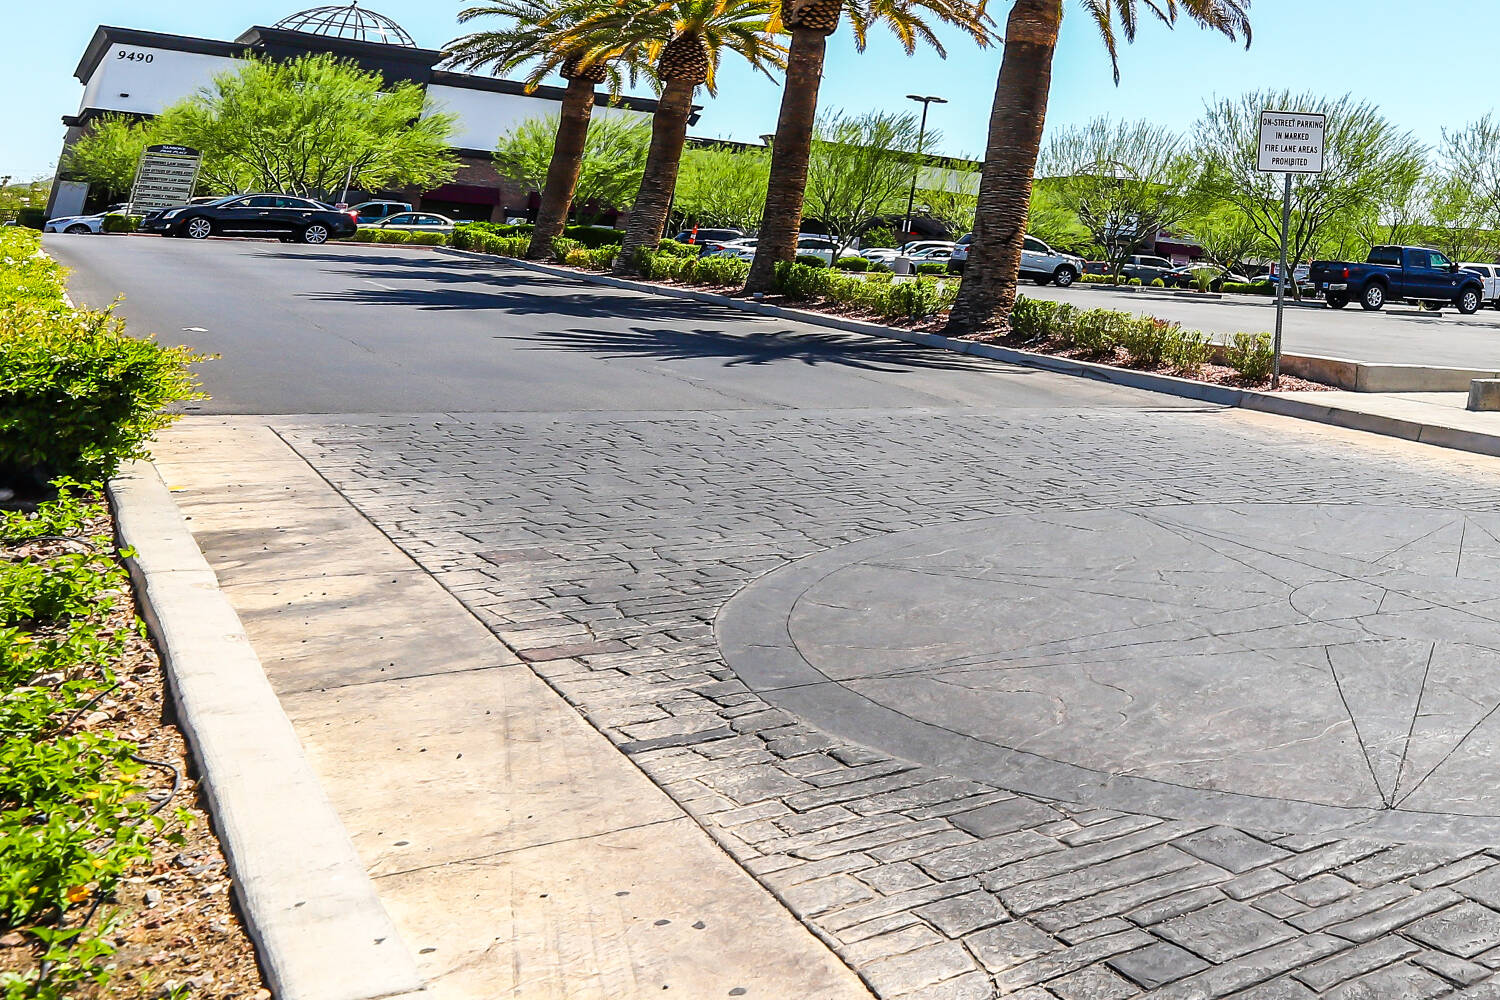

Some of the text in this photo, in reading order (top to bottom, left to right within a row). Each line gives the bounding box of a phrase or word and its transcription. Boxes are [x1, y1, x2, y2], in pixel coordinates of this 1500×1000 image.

[117, 50, 154, 64] 9490
[1262, 118, 1323, 129] ON-STREET PARKING
[1284, 132, 1309, 140] MARKED
[1264, 144, 1318, 154] FIRE LANE AREAS
[1271, 157, 1308, 166] PROHIBITED
